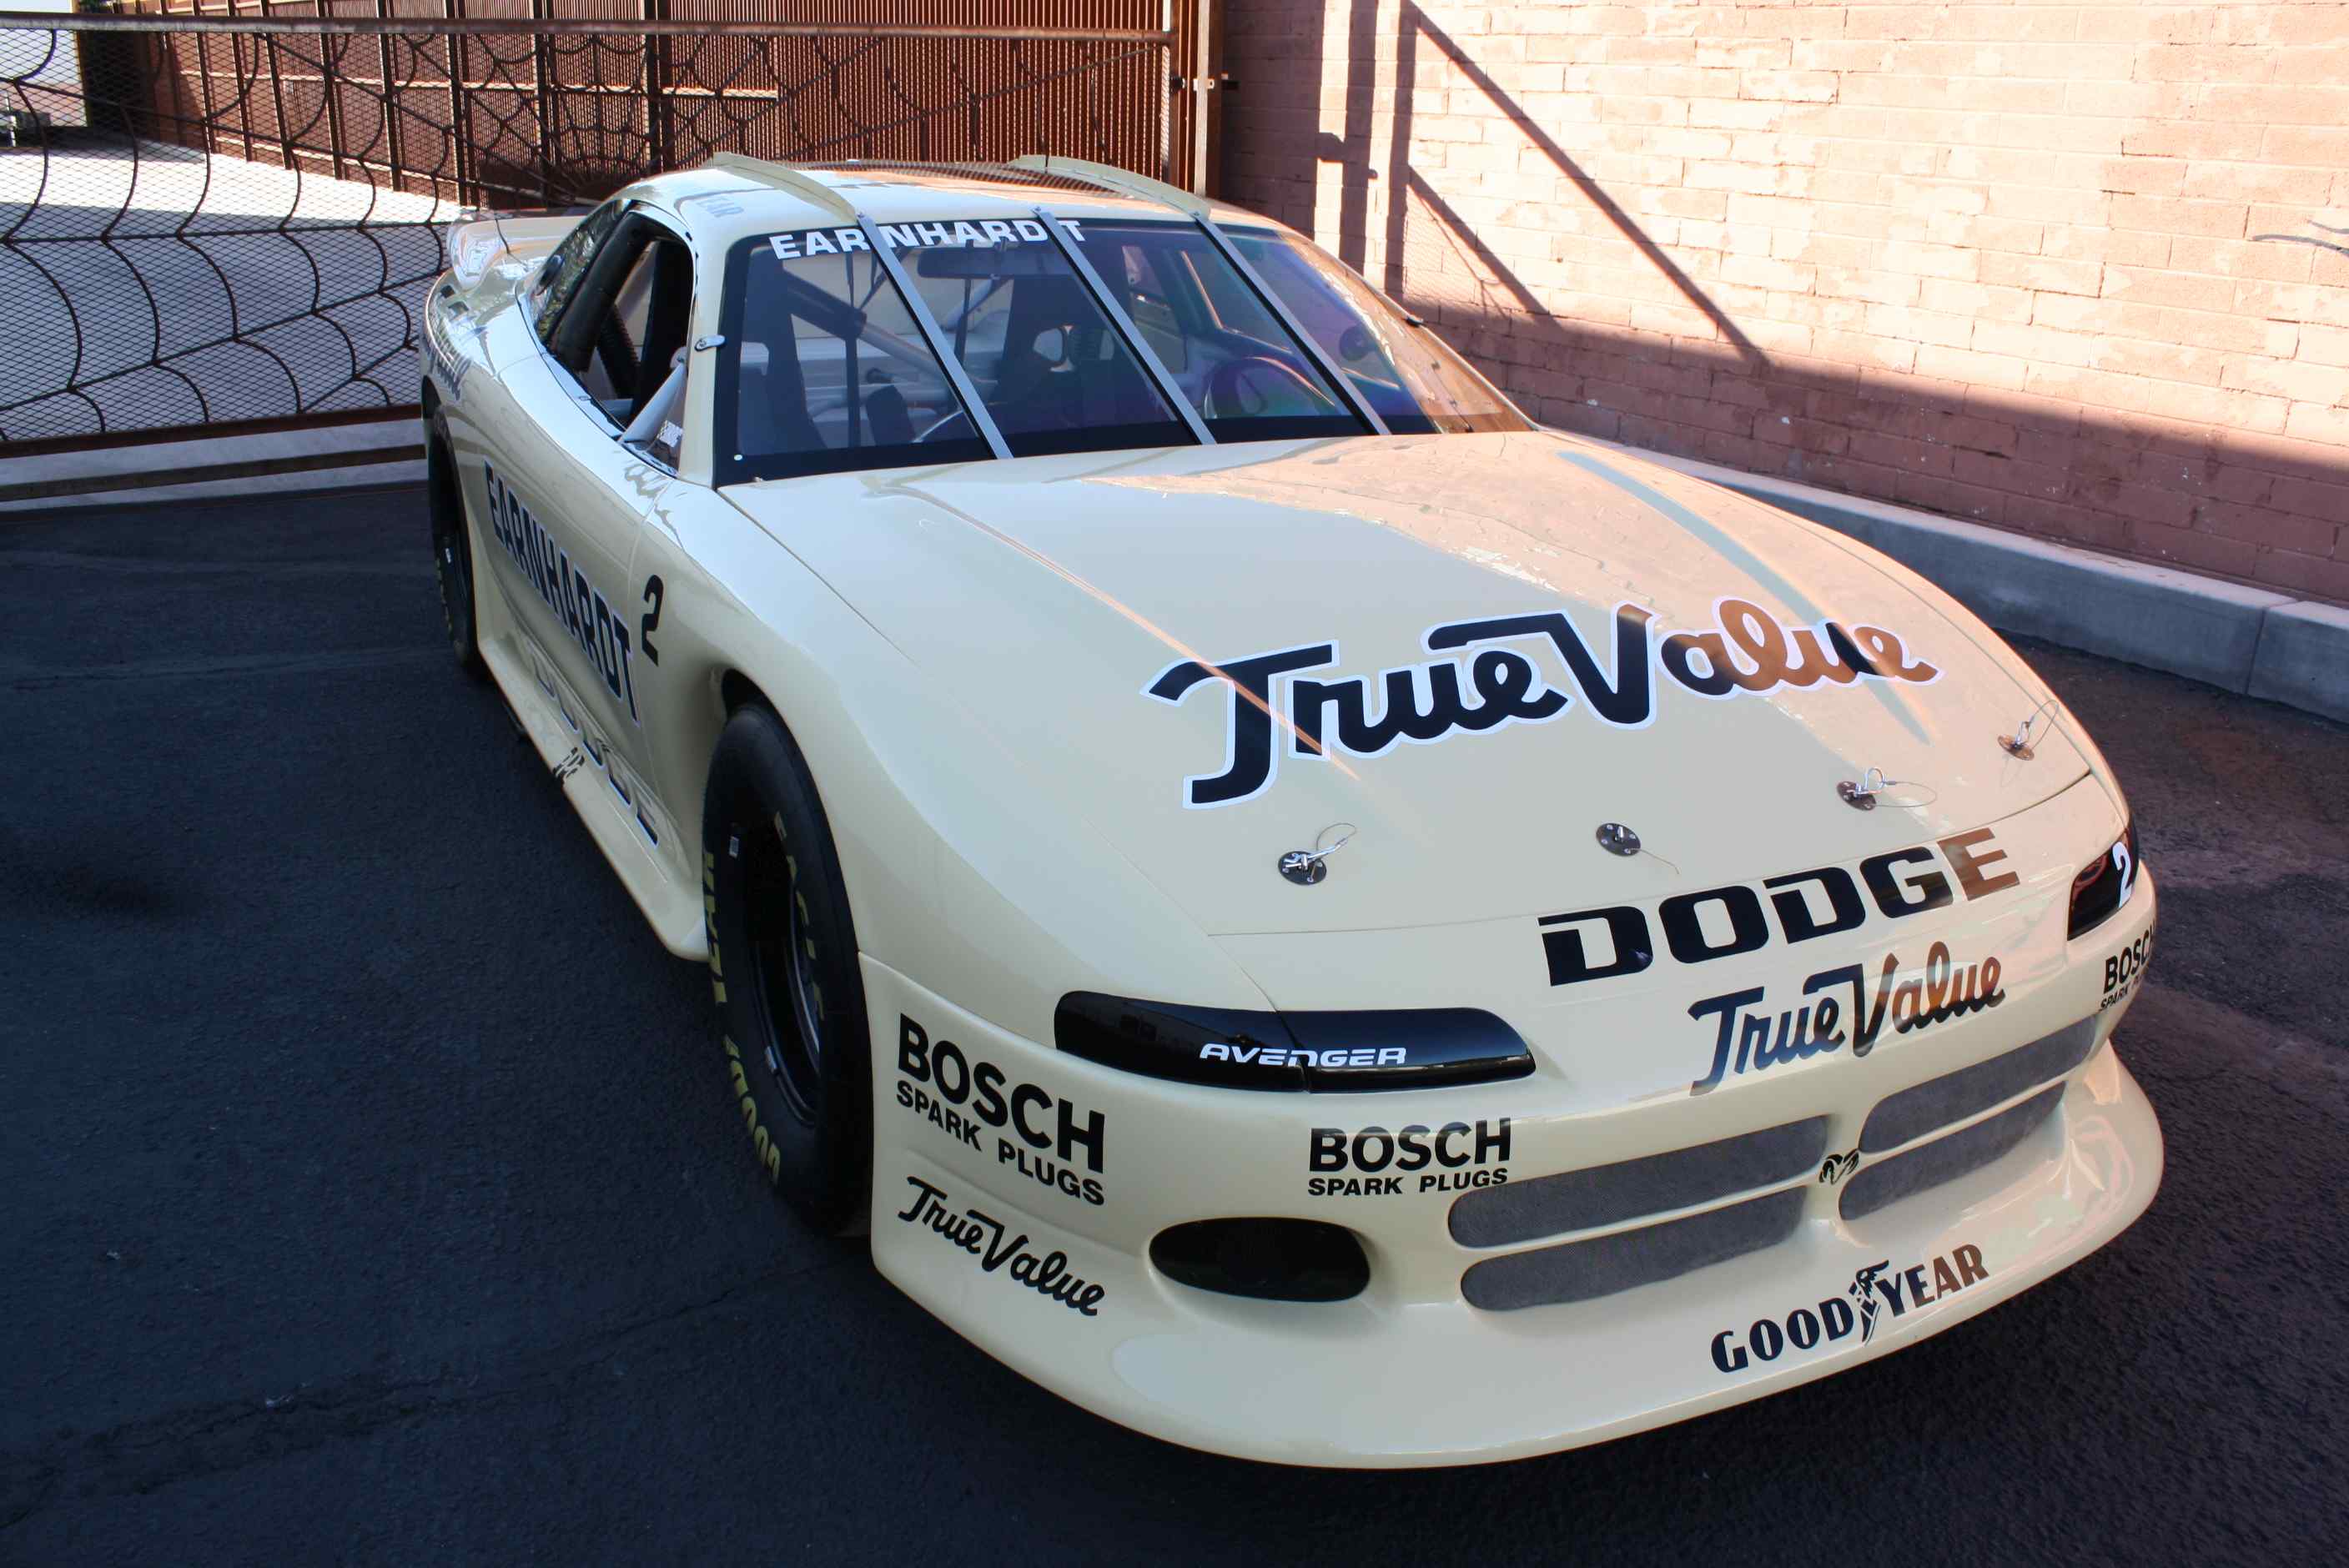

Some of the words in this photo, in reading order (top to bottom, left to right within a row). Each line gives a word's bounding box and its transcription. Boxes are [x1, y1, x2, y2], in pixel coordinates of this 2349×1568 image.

[769, 219, 1085, 259] EARNHARDT
[485, 459, 641, 727] EARNHARDT
[641, 575, 664, 666] 2
[1537, 827, 2020, 987] DODGE
[2112, 842, 2132, 907] 2
[898, 1013, 1104, 1173] BOSCH
[1200, 1043, 1406, 1068] AVENGER
[896, 1080, 982, 1152] SPARK
[998, 1137, 1104, 1206] PLUGS
[1308, 1177, 1404, 1196] SPARK
[1419, 1168, 1508, 1193] PLUGS
[1309, 1118, 1512, 1173] BOSCH
